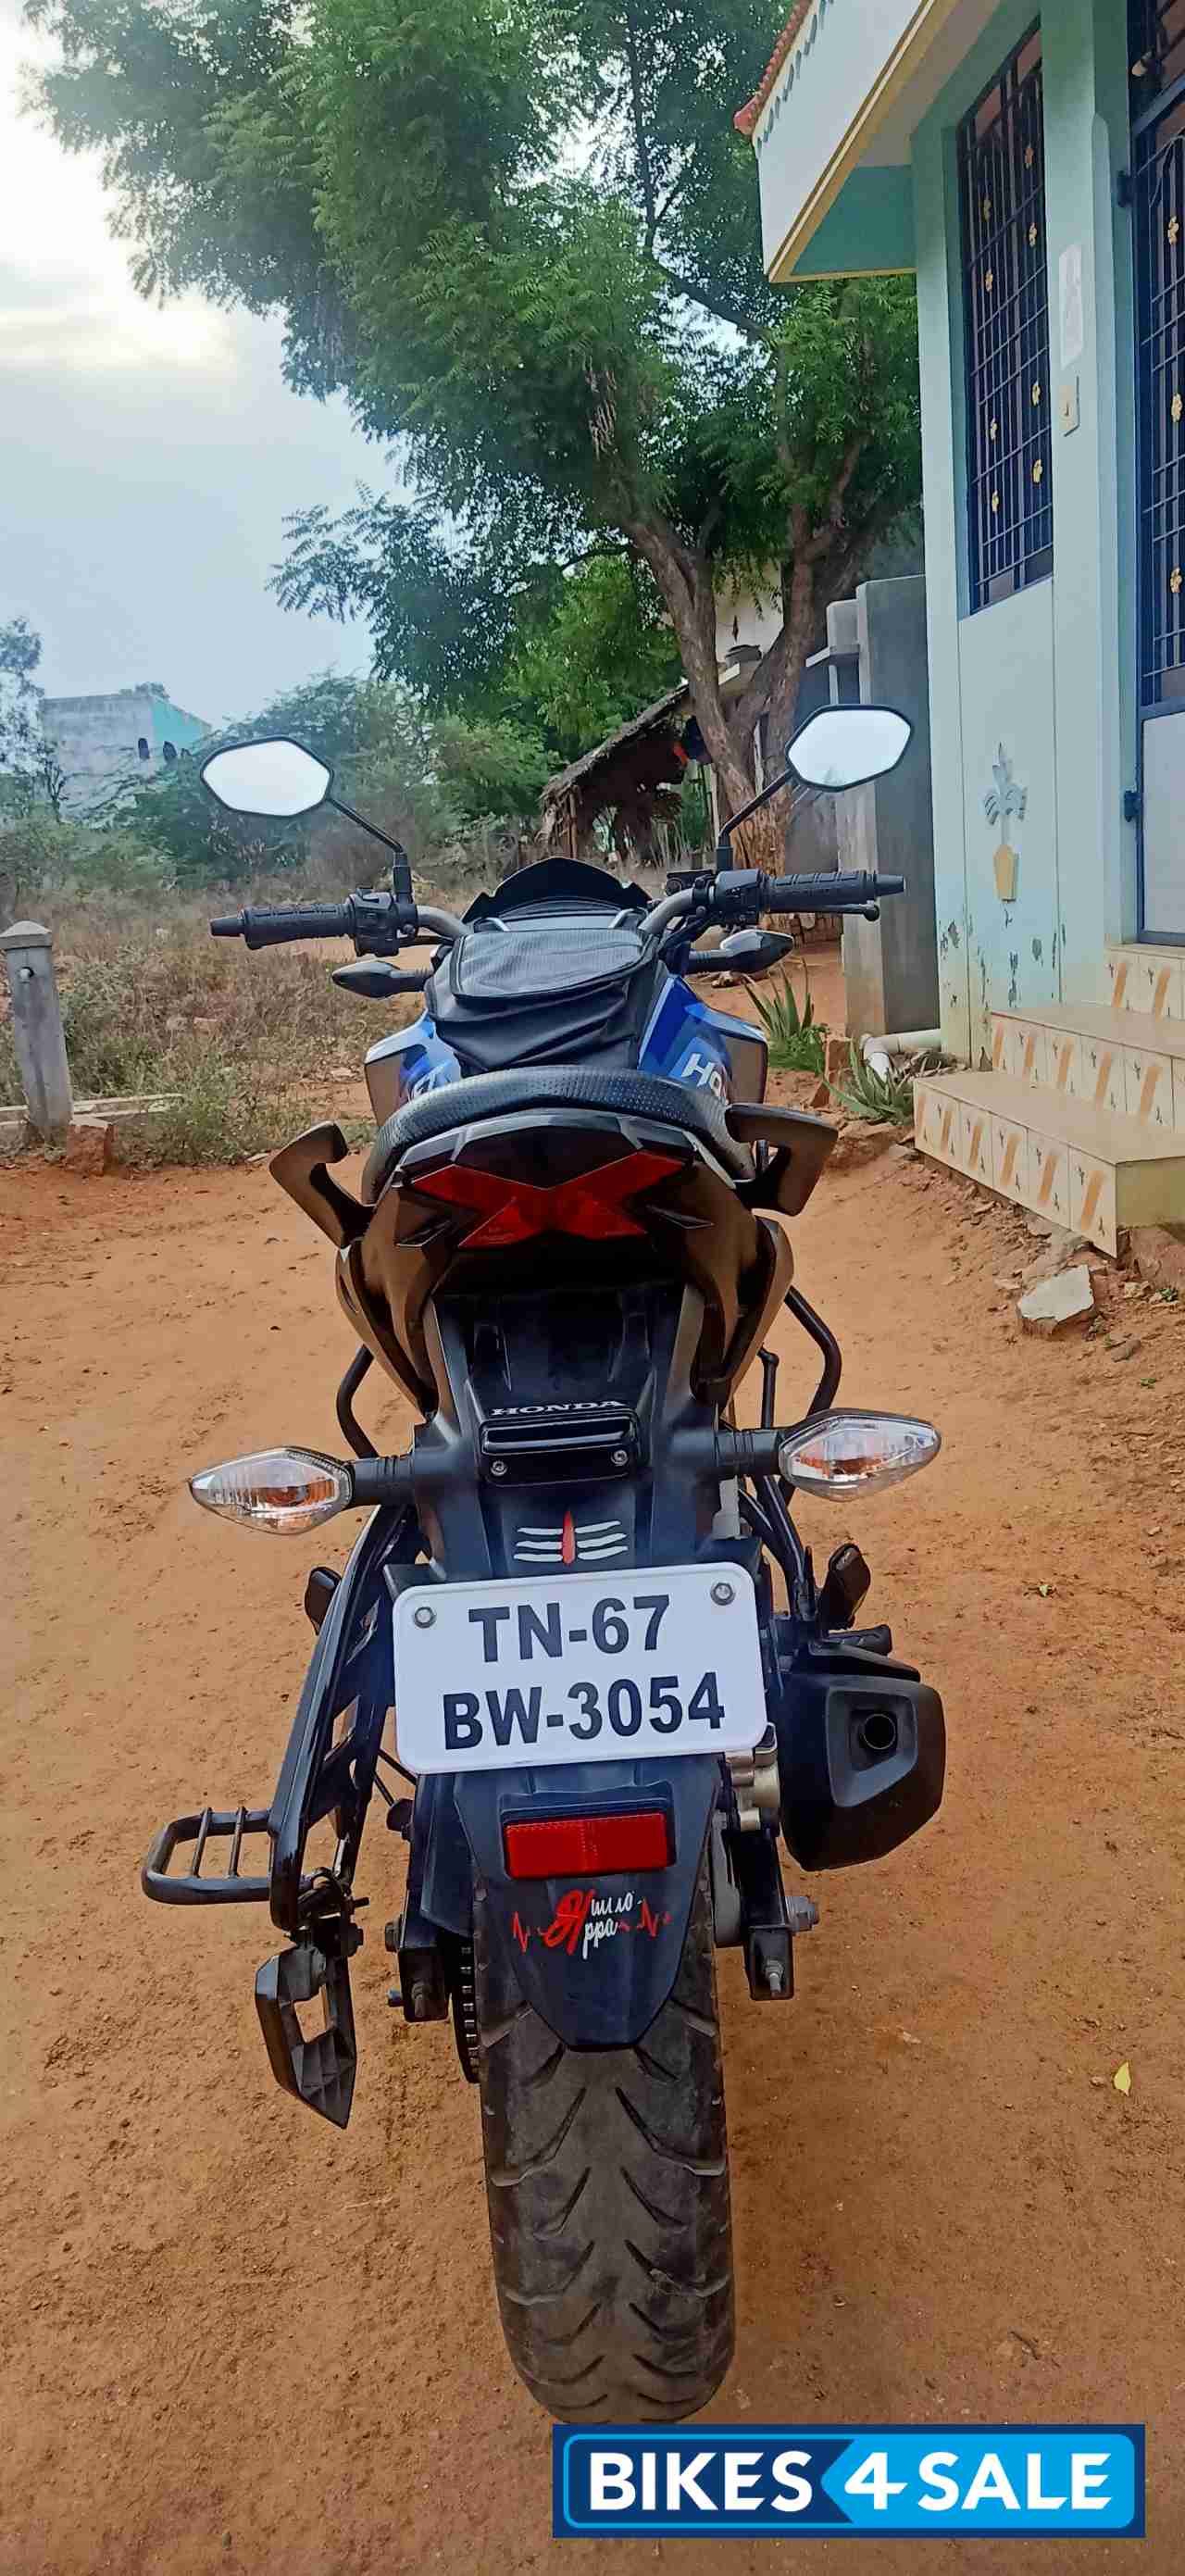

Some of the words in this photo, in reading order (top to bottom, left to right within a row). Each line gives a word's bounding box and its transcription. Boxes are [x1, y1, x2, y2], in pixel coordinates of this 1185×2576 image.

[491, 1401, 626, 1416] HONDA
[468, 1594, 671, 1663] TN-67
[443, 1672, 726, 1751] BW-3054
